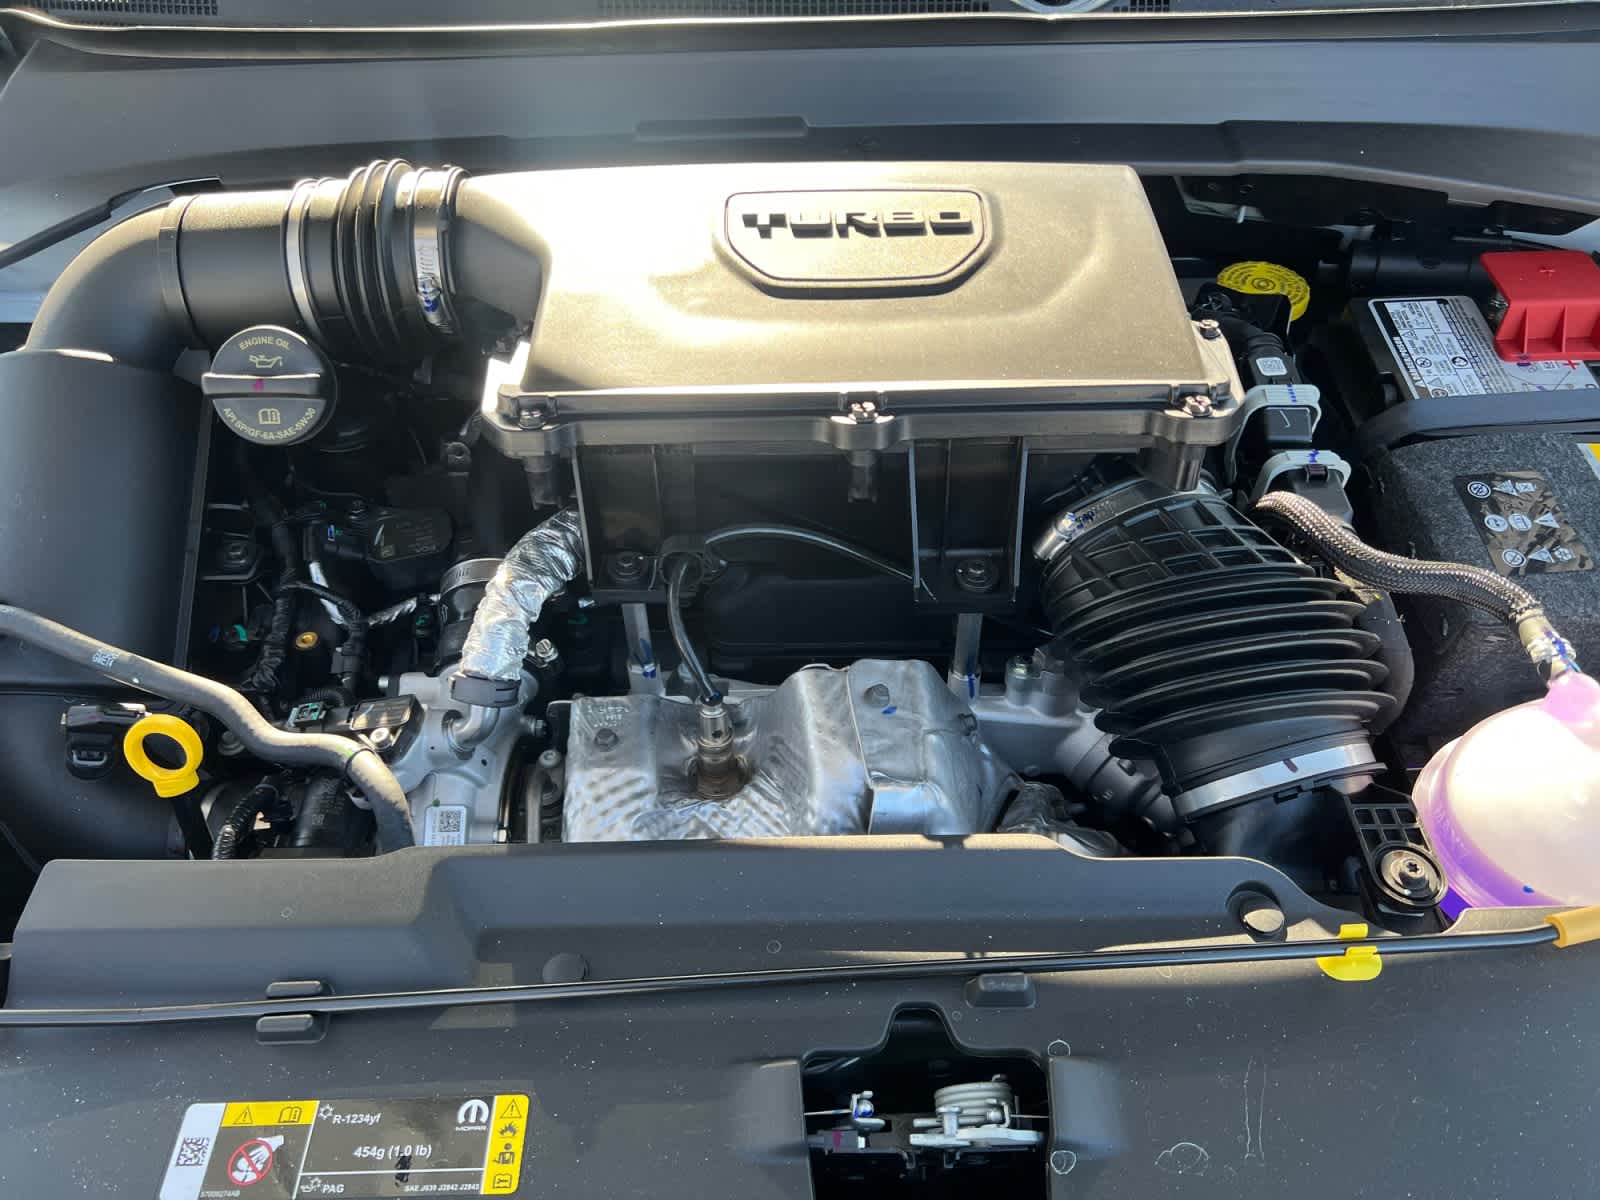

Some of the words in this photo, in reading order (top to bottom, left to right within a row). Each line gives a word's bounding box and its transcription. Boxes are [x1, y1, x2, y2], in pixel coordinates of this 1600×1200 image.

[741, 209, 975, 239] TURBO
[239, 335, 274, 350] ENGINE
[275, 338, 290, 350] OIL
[332, 1112, 382, 1126] R-1234yf
[353, 1146, 385, 1160] 454g
[388, 1145, 412, 1160] (1.0
[415, 1144, 432, 1159] lb)
[322, 1183, 345, 1193] PAG
